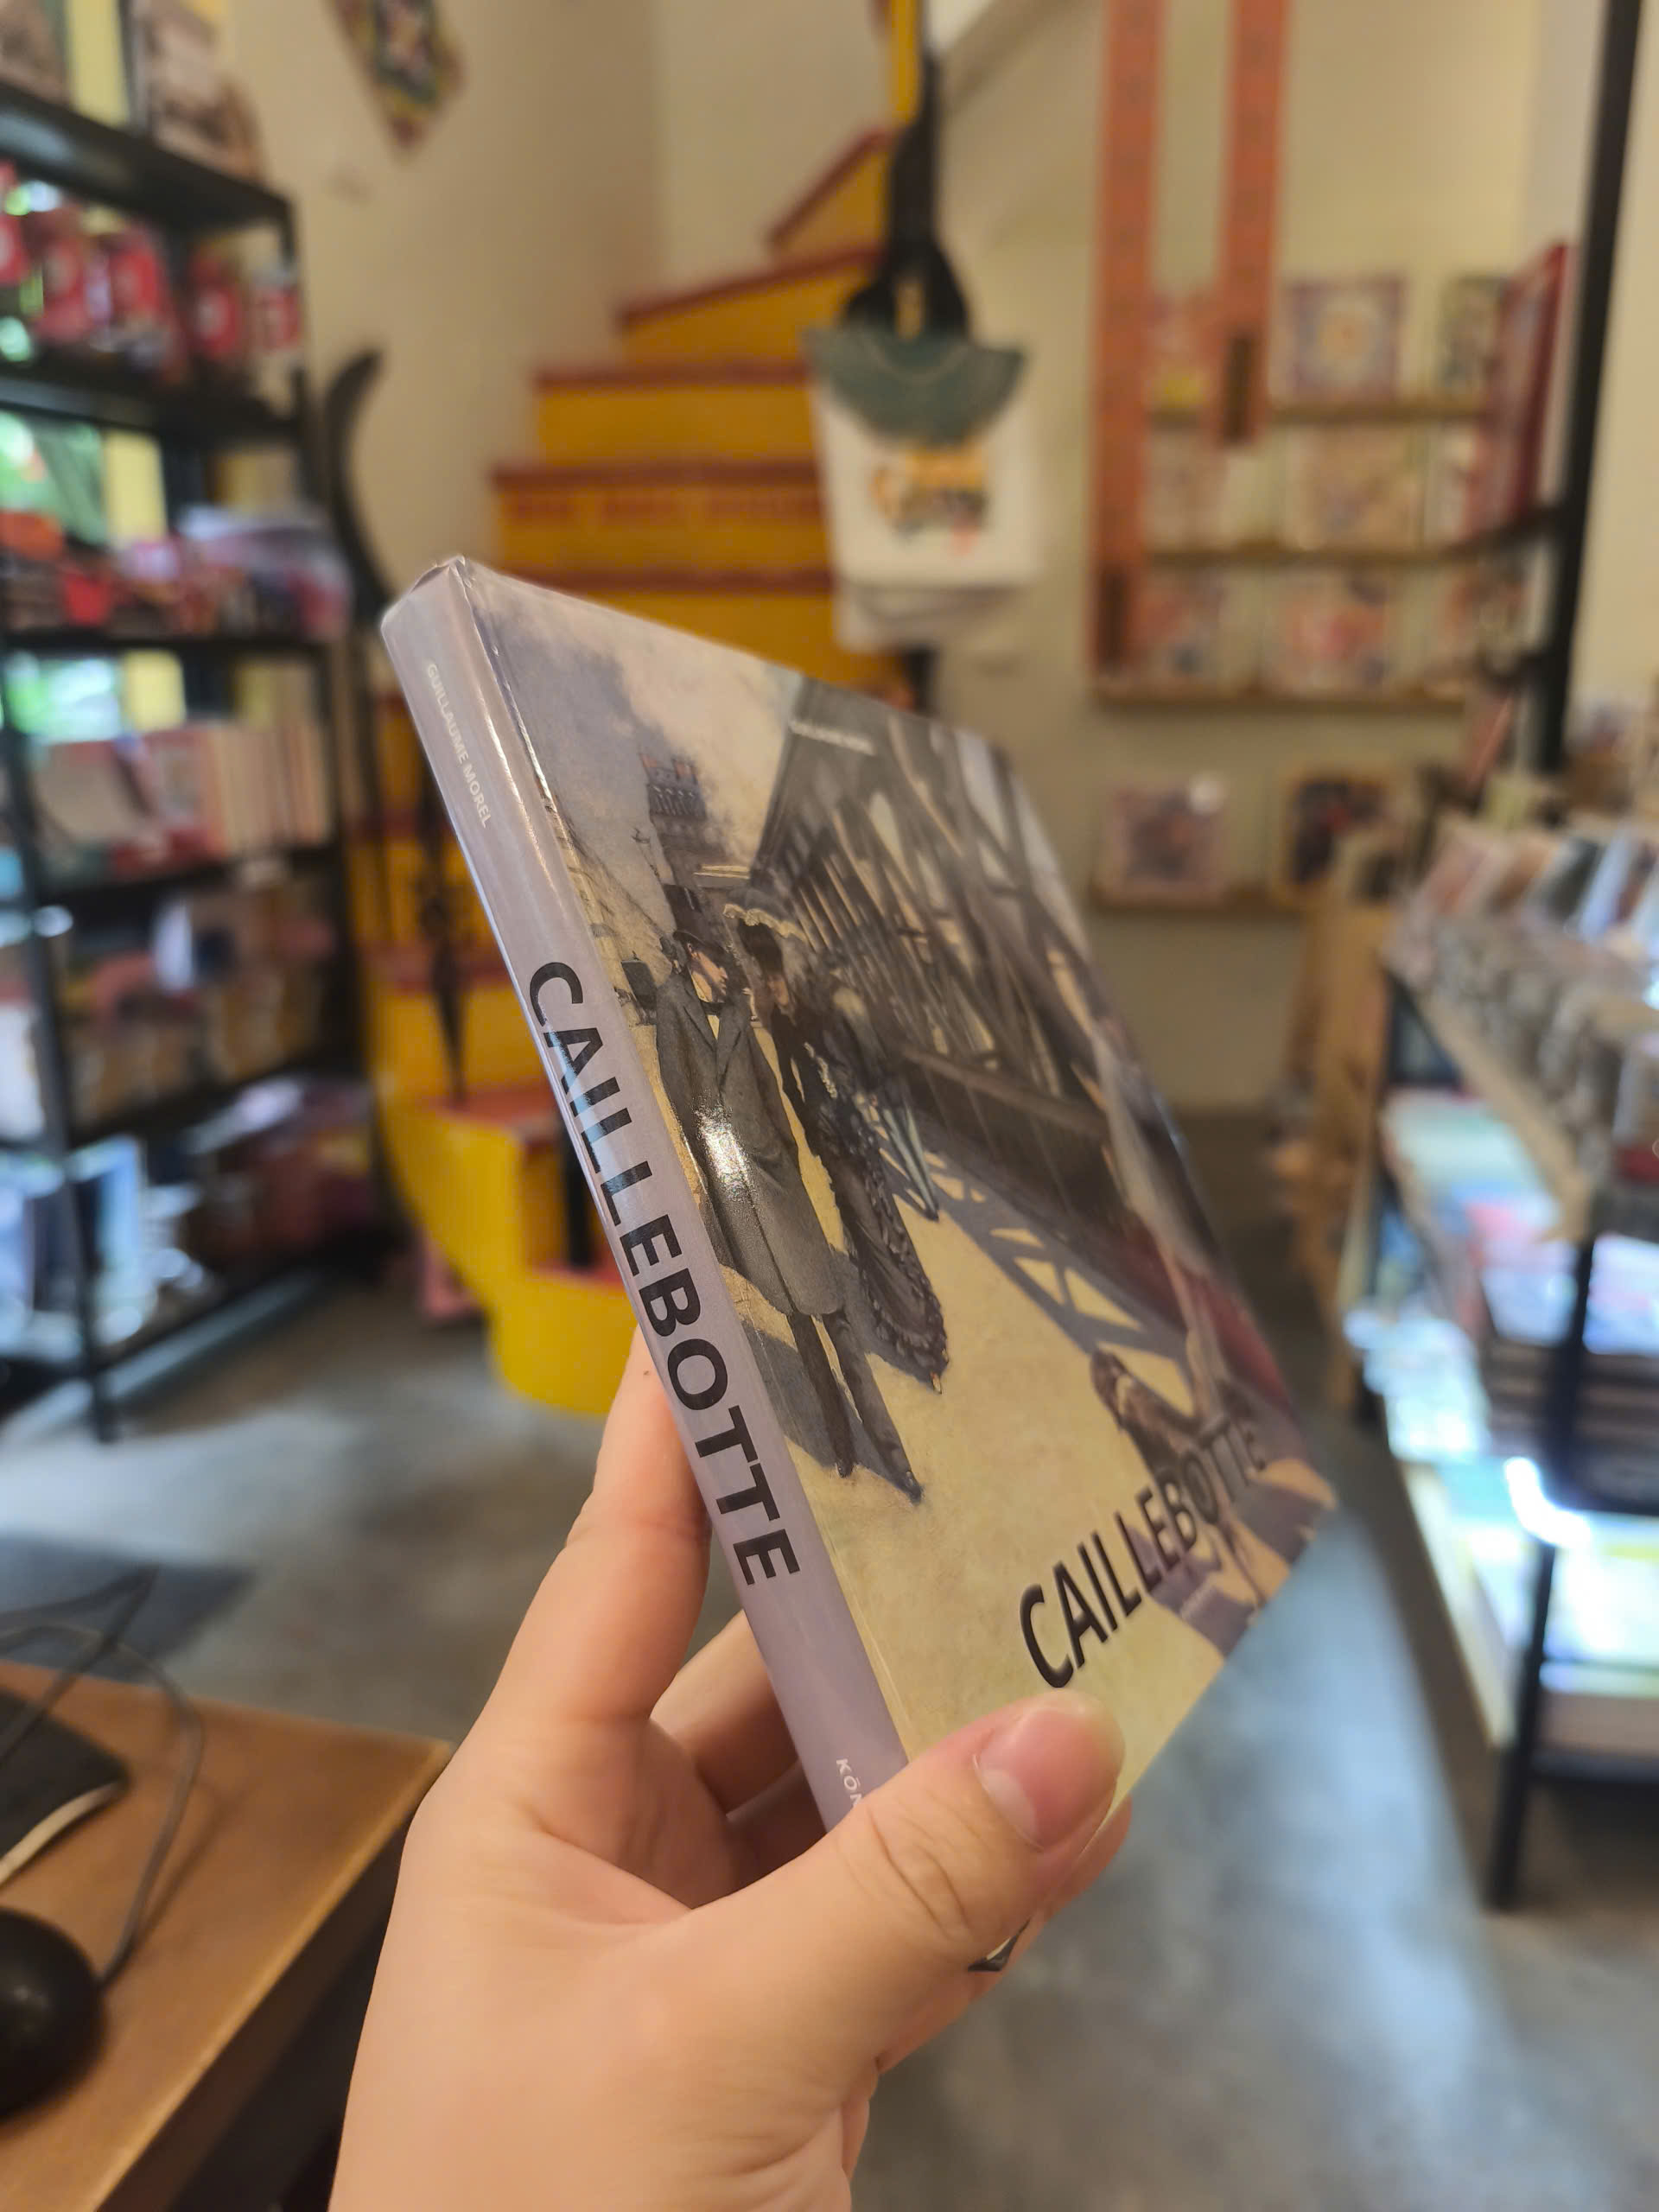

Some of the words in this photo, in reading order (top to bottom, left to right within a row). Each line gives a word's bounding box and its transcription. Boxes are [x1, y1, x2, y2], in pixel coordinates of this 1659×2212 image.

[428, 663, 469, 764] GUILLAUME
[462, 763, 492, 829] MOREL
[529, 961, 801, 1586] CAILLEBOTTE
[1020, 1421, 1267, 1688] CAILLEBOTTE
